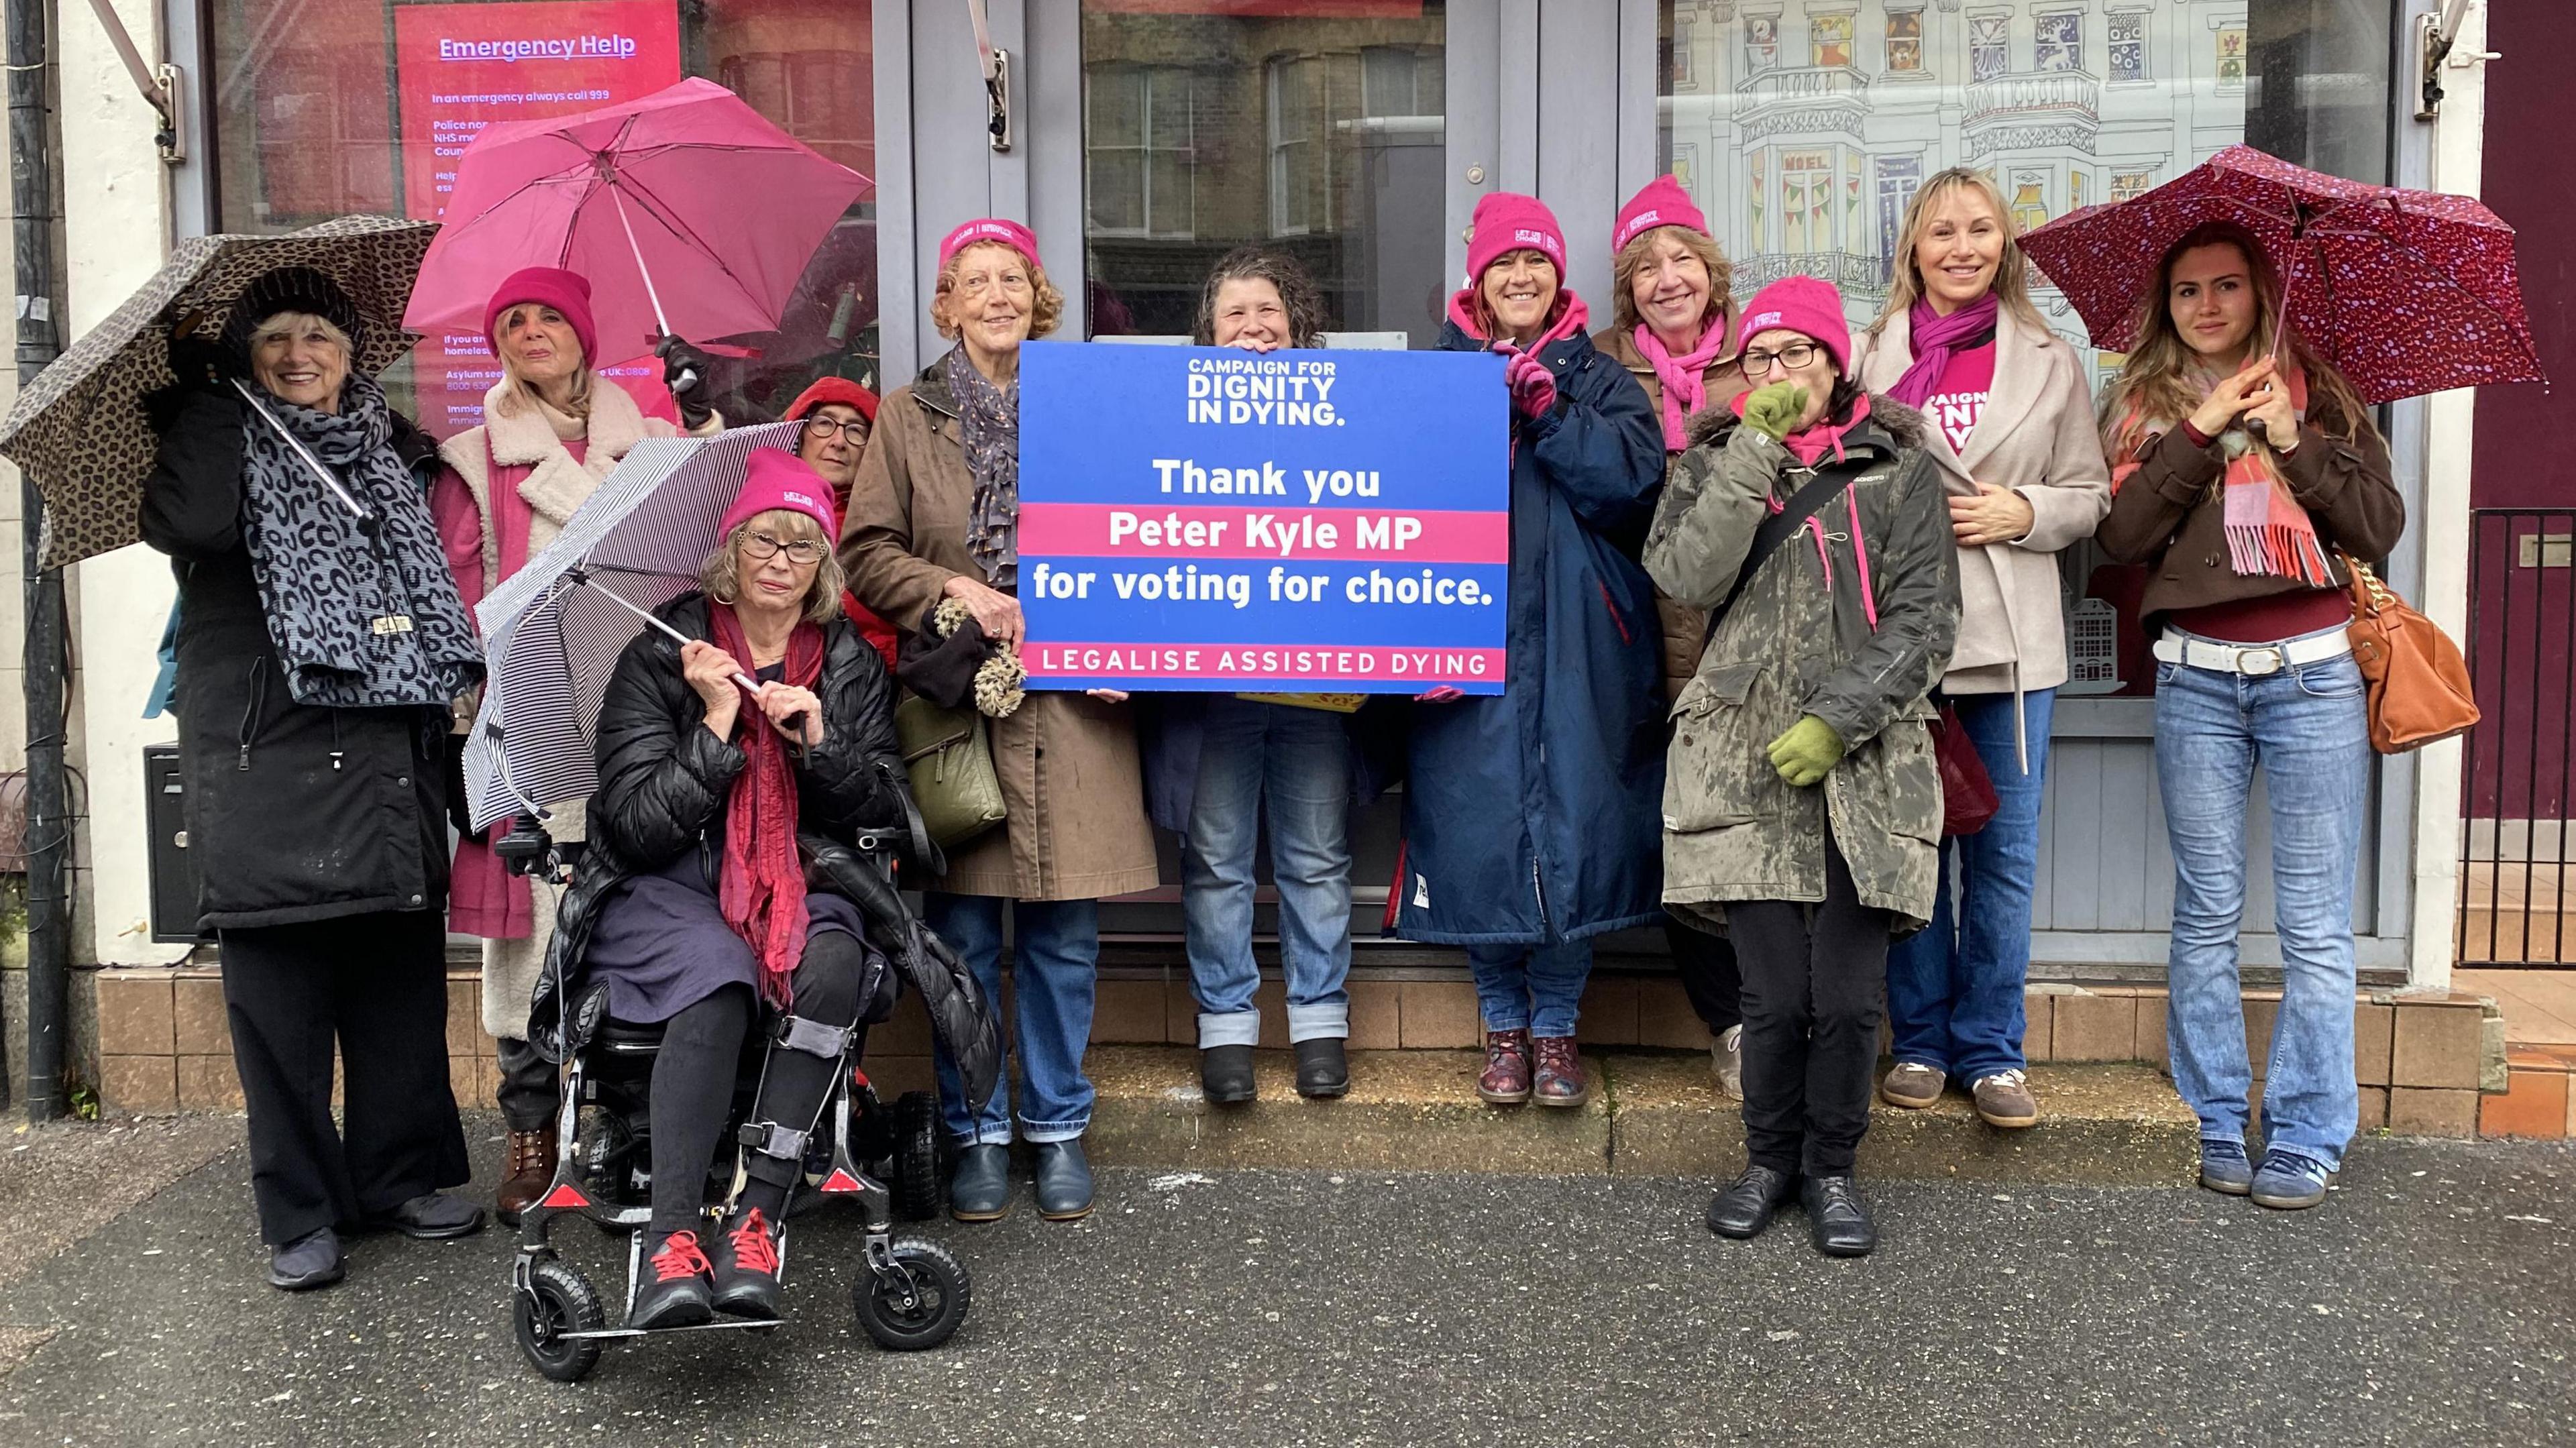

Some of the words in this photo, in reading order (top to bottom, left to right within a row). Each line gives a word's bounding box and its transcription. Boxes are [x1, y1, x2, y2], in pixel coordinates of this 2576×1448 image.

[439, 38, 576, 62] Emergency
[581, 34, 637, 59] Help
[432, 94, 443, 103] In
[462, 93, 523, 105] emergency
[526, 92, 566, 103] always
[567, 90, 588, 101] call
[589, 90, 610, 100] 999
[433, 119, 466, 130] Police
[434, 133, 457, 143] NHS
[1784, 156, 1827, 170] NOEL
[443, 335, 451, 344] If
[451, 337, 471, 346] you
[446, 370, 483, 381] Asylum
[626, 368, 650, 376] 0808
[1188, 359, 1289, 375] CAMPAIGN
[1297, 361, 1336, 376] FOR
[446, 382, 470, 390] 8000
[1187, 376, 1336, 401] DIGNITY
[1187, 400, 1222, 423] IN
[1229, 401, 1345, 427] DYING.
[1152, 459, 1287, 495] Thank
[1302, 469, 1380, 504] you
[1109, 511, 1228, 548] Peter
[1245, 514, 1338, 557] Kyle
[1355, 516, 1422, 551] MP
[1032, 563, 1096, 600] for
[1112, 564, 1250, 610] voting
[1267, 565, 1330, 602] for
[1345, 568, 1493, 606] choice.
[1042, 649, 1201, 671] LEGALISE
[1217, 651, 1375, 673] ASSISTED
[1391, 653, 1486, 675] DYING
